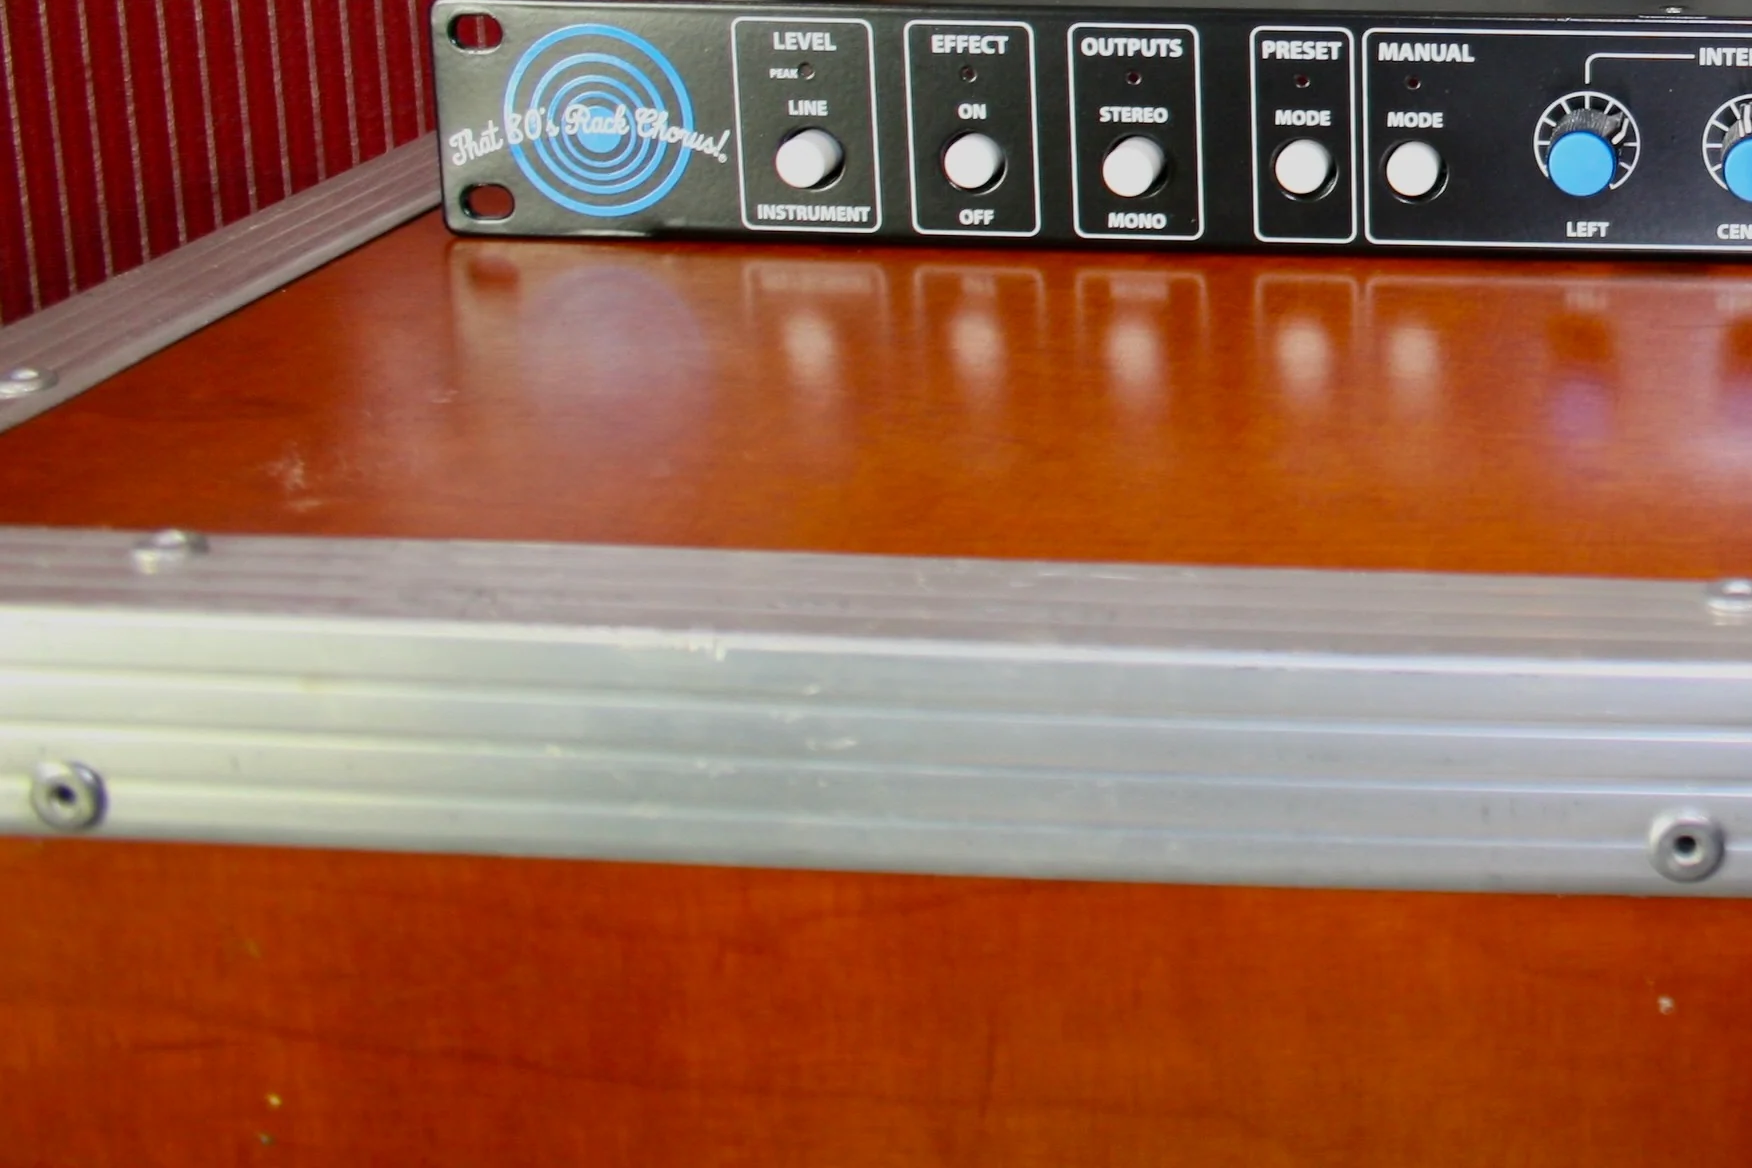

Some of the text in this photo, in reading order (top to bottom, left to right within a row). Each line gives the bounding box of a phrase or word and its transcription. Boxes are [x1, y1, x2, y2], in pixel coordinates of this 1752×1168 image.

[771, 31, 838, 52] LEVEL
[930, 34, 1009, 56] EFFECT
[1080, 37, 1184, 59] OUTPUTS
[1261, 40, 1343, 62] PRESET
[1377, 41, 1476, 64] MANUAL
[769, 67, 799, 80] PEAK
[787, 99, 829, 117] LINE
[957, 103, 987, 121] ON
[1099, 106, 1169, 125] STEREO
[563, 103, 630, 137] Rack
[1274, 109, 1332, 128] MODE
[1386, 110, 1444, 129] MODE
[756, 204, 872, 224] INSTRUMENT
[959, 208, 995, 227] OFF
[1107, 212, 1168, 231] MONO
[1566, 220, 1610, 239] LEFT
